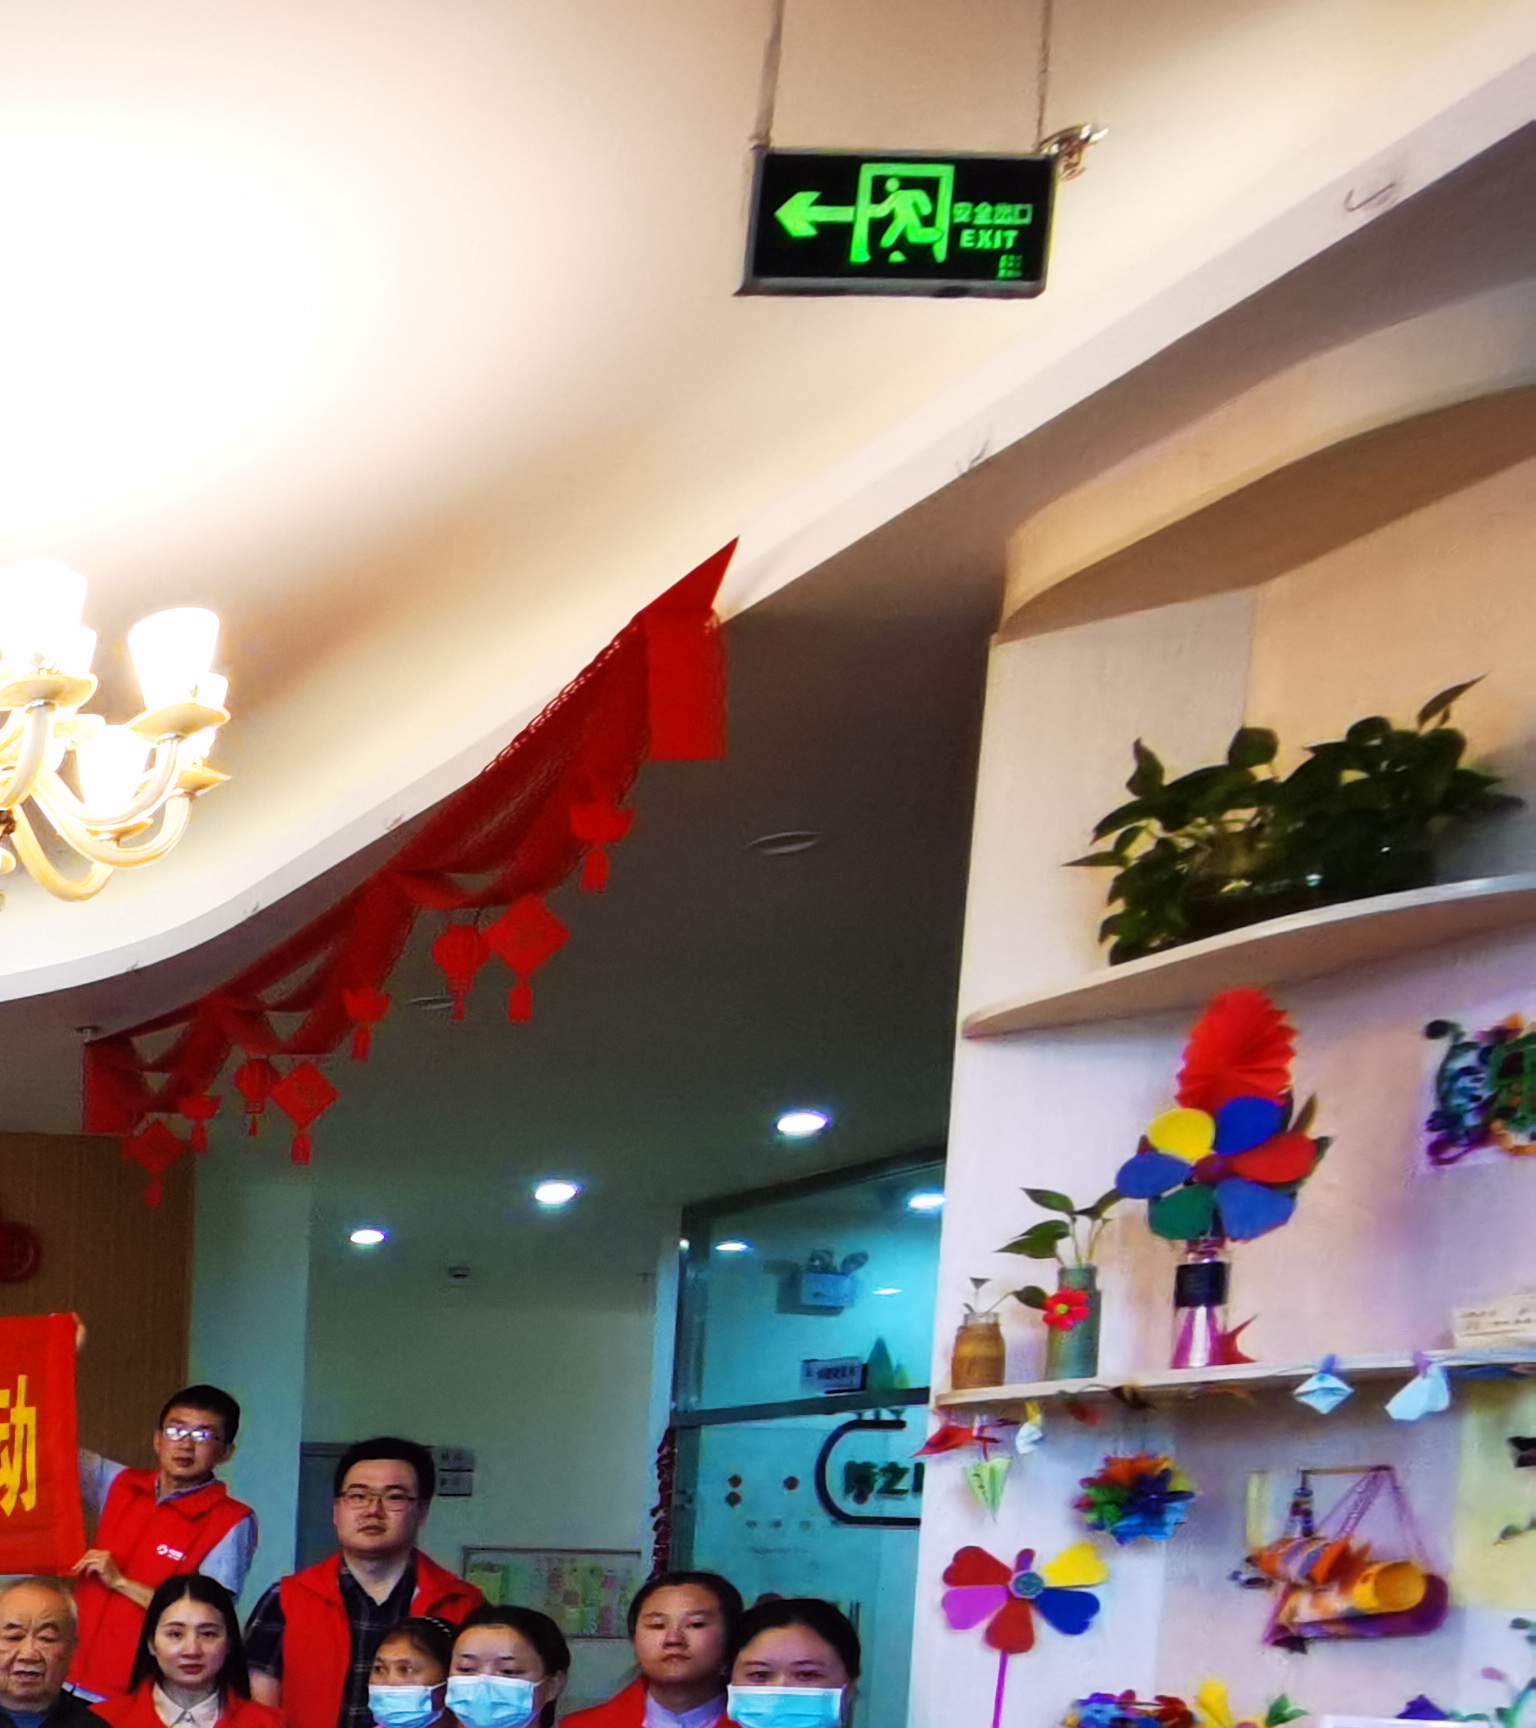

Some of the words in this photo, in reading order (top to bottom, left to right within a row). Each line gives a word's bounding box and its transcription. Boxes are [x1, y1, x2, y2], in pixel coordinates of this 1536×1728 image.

[953, 202, 1033, 225] 安全出口
[959, 229, 1019, 250] EXIT
